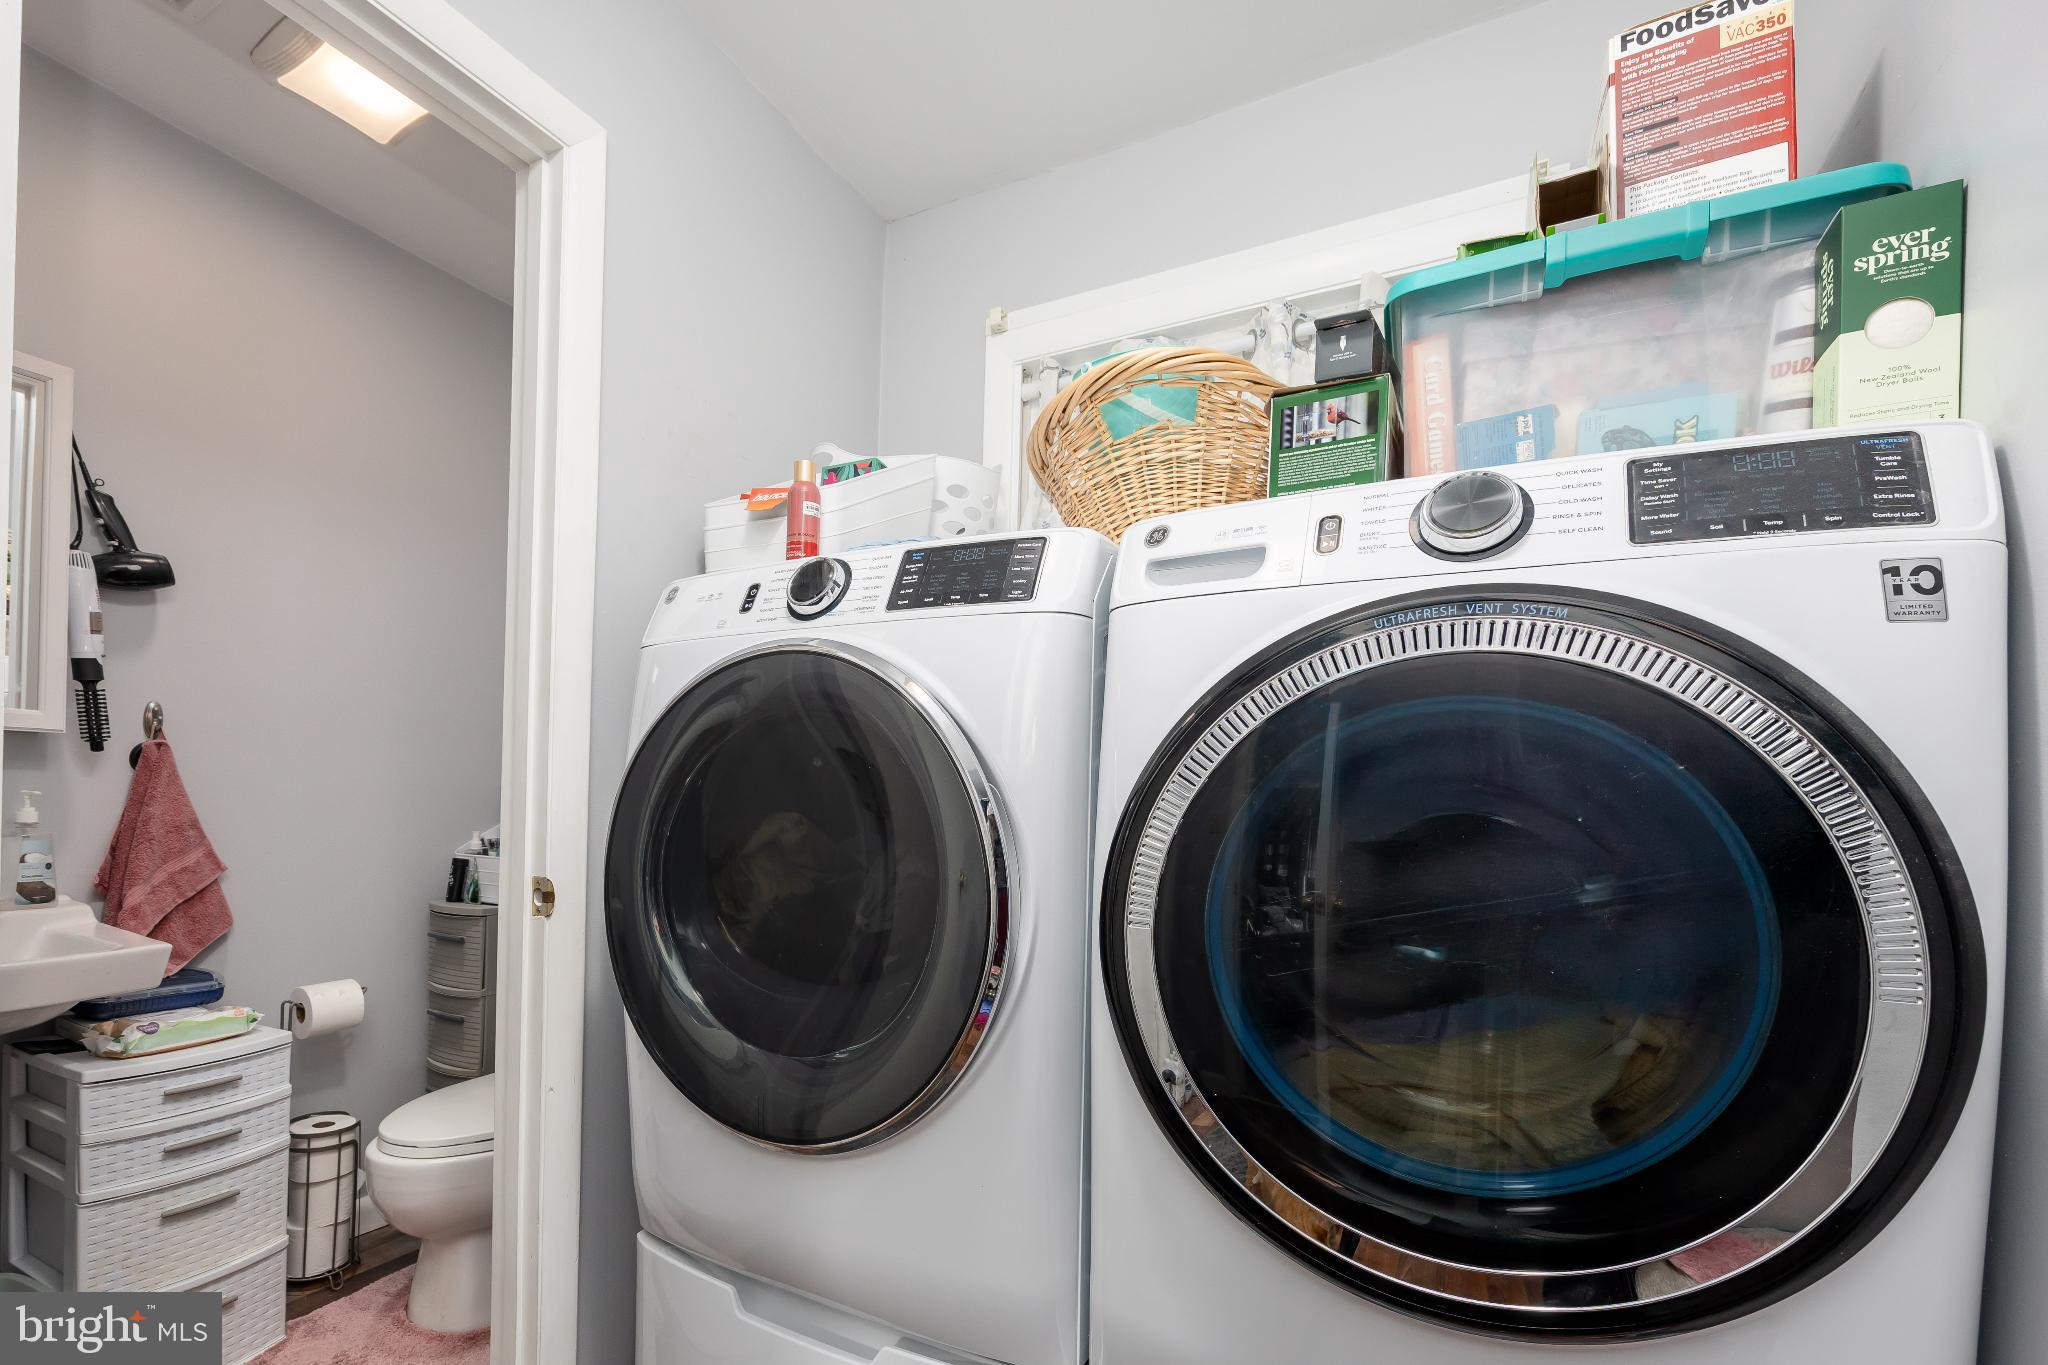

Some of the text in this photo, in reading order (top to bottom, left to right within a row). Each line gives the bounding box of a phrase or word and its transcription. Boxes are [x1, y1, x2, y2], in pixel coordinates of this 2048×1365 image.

[1621, 37, 1695, 67] Enjoy the Benefits of
[1621, 49, 1687, 74] Vacuum Packaging
[1621, 60, 1677, 81] with FoodSaver
[1629, 185, 1642, 193] This
[1643, 178, 1669, 189] Package
[1872, 226, 1936, 253] ever
[1853, 236, 1953, 276] spring
[1859, 365, 1942, 385] New Zealand Wool
[1888, 364, 1912, 373] 100%
[1875, 375, 1924, 388] Dryer Balls
[1849, 411, 1876, 419] Reduces
[1860, 437, 1909, 445] ULTRAFRESH
[1555, 469, 1579, 477] QUICK
[1643, 466, 1672, 474] Settings
[1561, 481, 1602, 490] DELICATES
[1360, 518, 1387, 526] TOWELS
[1577, 525, 1604, 533] CLEAN
[1650, 528, 1673, 536] Sound
[1882, 564, 1943, 596] 10
[1374, 602, 1569, 629] ULTRAFRESH VENT SYSTEM
